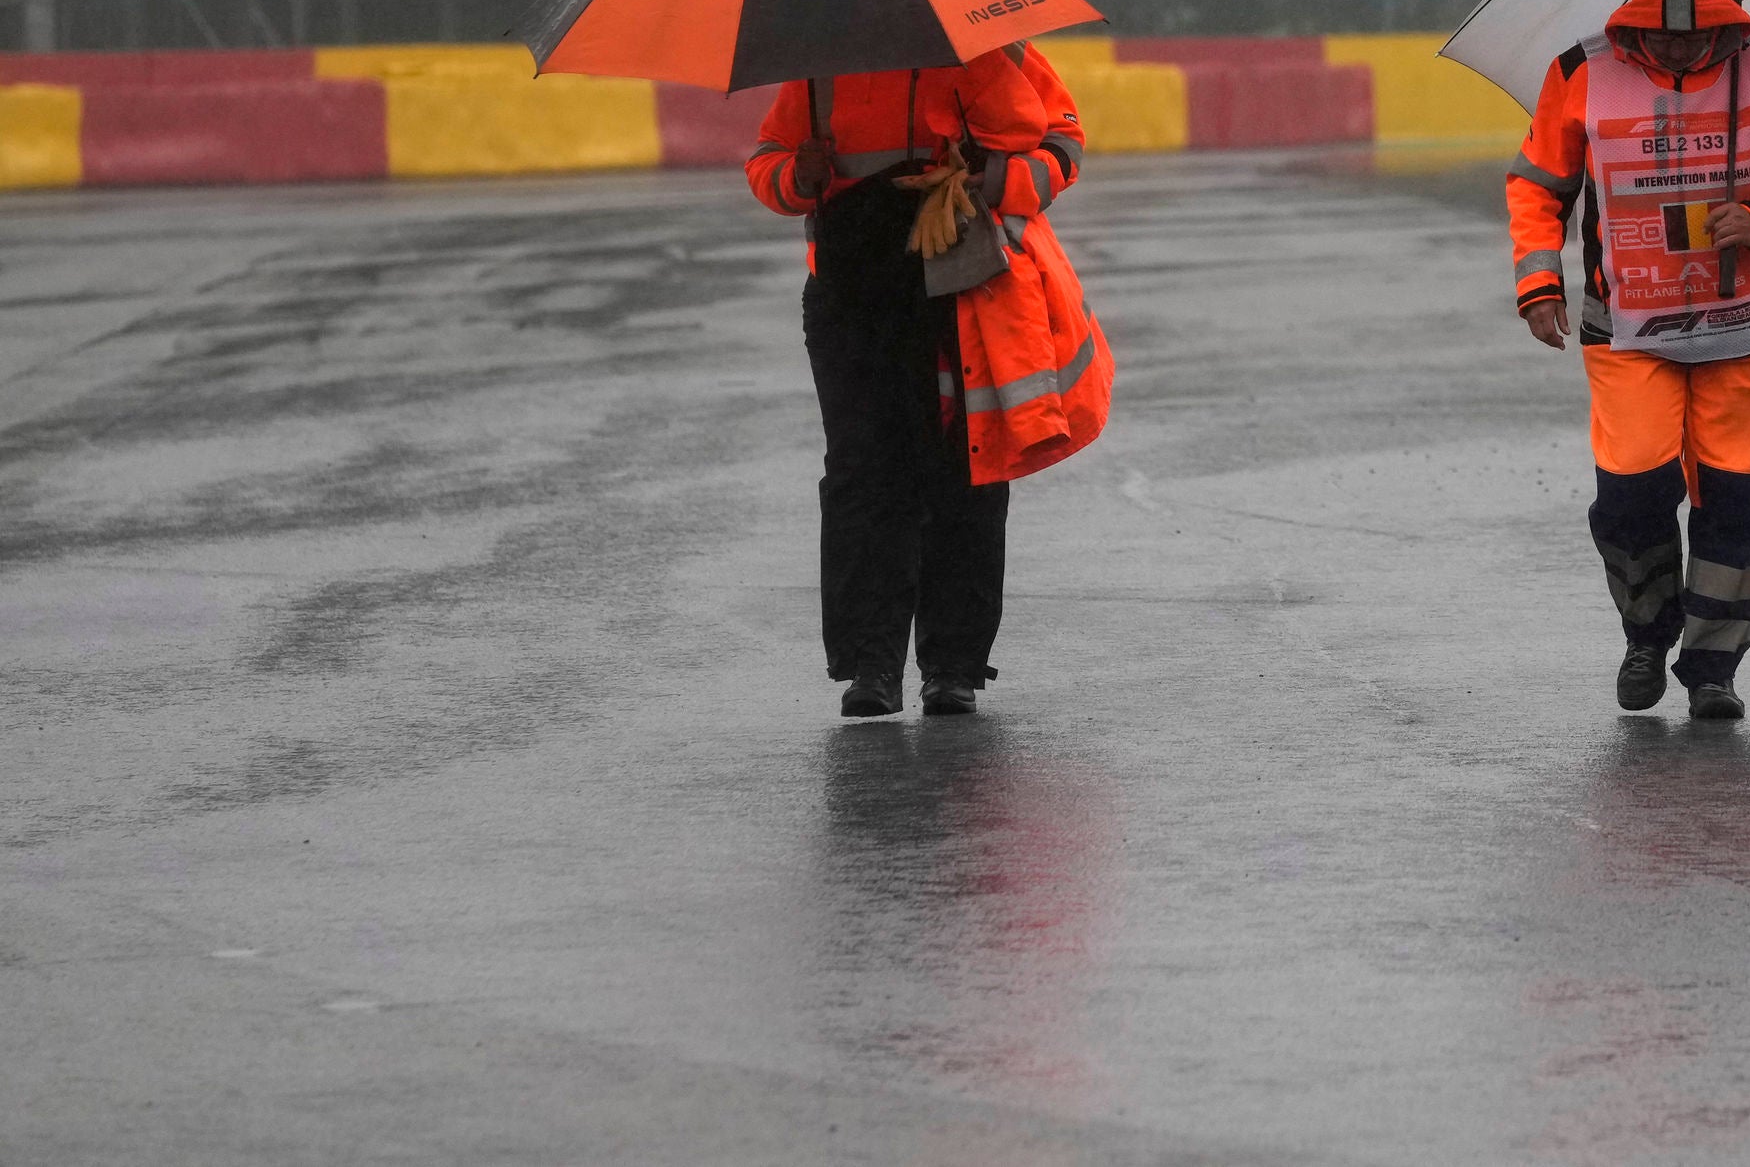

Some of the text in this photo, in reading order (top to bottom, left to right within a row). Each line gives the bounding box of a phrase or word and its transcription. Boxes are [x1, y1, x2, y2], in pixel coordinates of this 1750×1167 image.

[1641, 134, 1725, 154] BEL2 133
[1634, 173, 1706, 188] INTERVENTION
[1625, 275, 1746, 299] PIT LANE ALL TES
